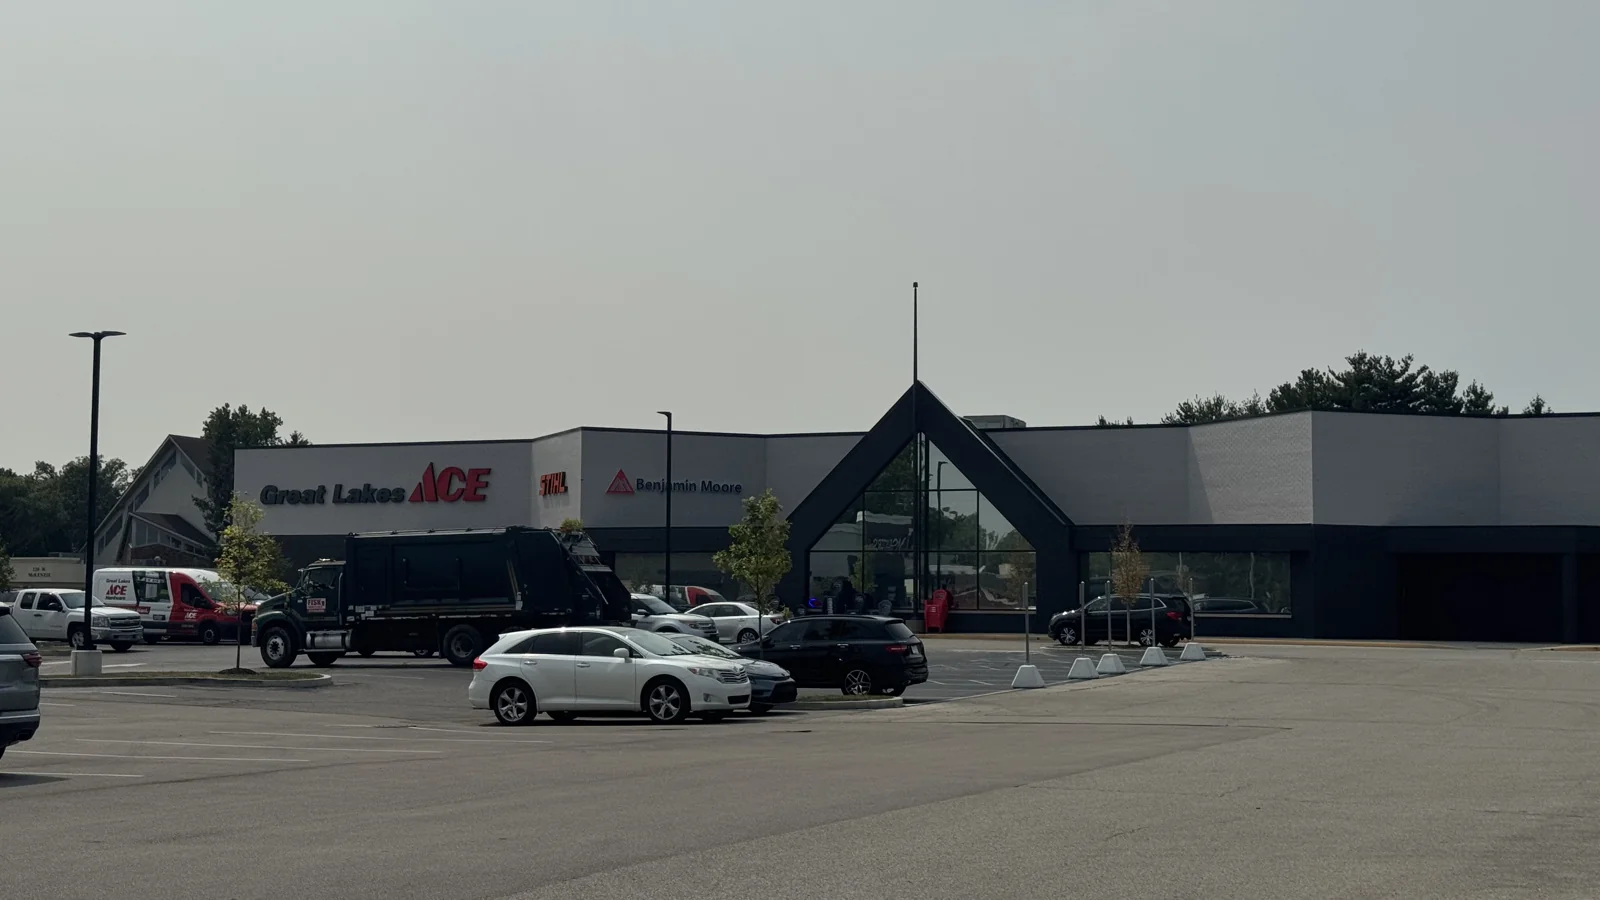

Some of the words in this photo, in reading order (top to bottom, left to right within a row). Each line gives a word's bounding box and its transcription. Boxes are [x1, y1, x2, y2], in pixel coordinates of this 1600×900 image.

[260, 485, 327, 504] Great
[332, 483, 406, 504] Lakes
[408, 461, 492, 503] ACE
[539, 471, 568, 496] STIHL
[701, 480, 743, 493] Moore
[106, 584, 128, 596] ACE
